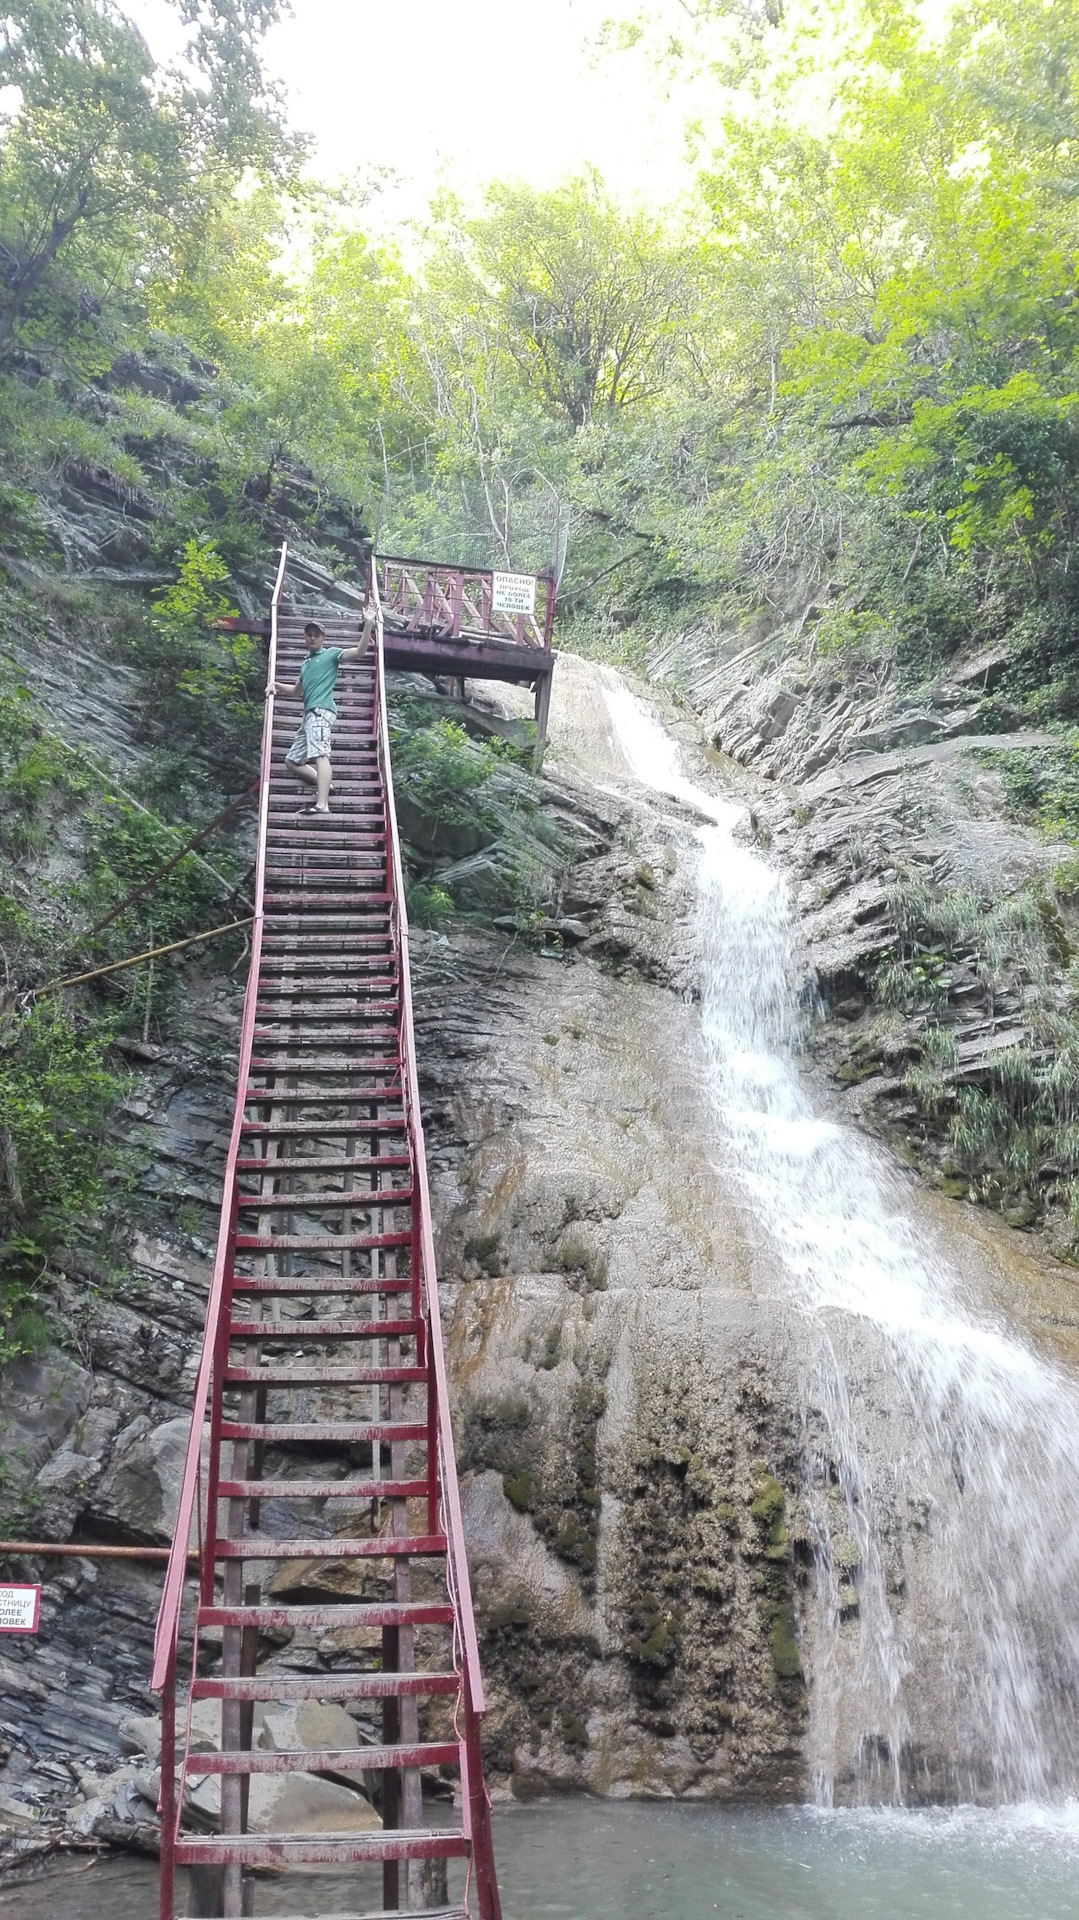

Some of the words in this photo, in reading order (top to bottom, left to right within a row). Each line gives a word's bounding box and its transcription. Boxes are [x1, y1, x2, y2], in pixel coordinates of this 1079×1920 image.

[496, 576, 534, 586] ОПАСНО!
[499, 584, 529, 592] ПРОХОД
[496, 602, 530, 610] ЧЕЛОВЕК
[0, 1590, 13, 1598] ОД
